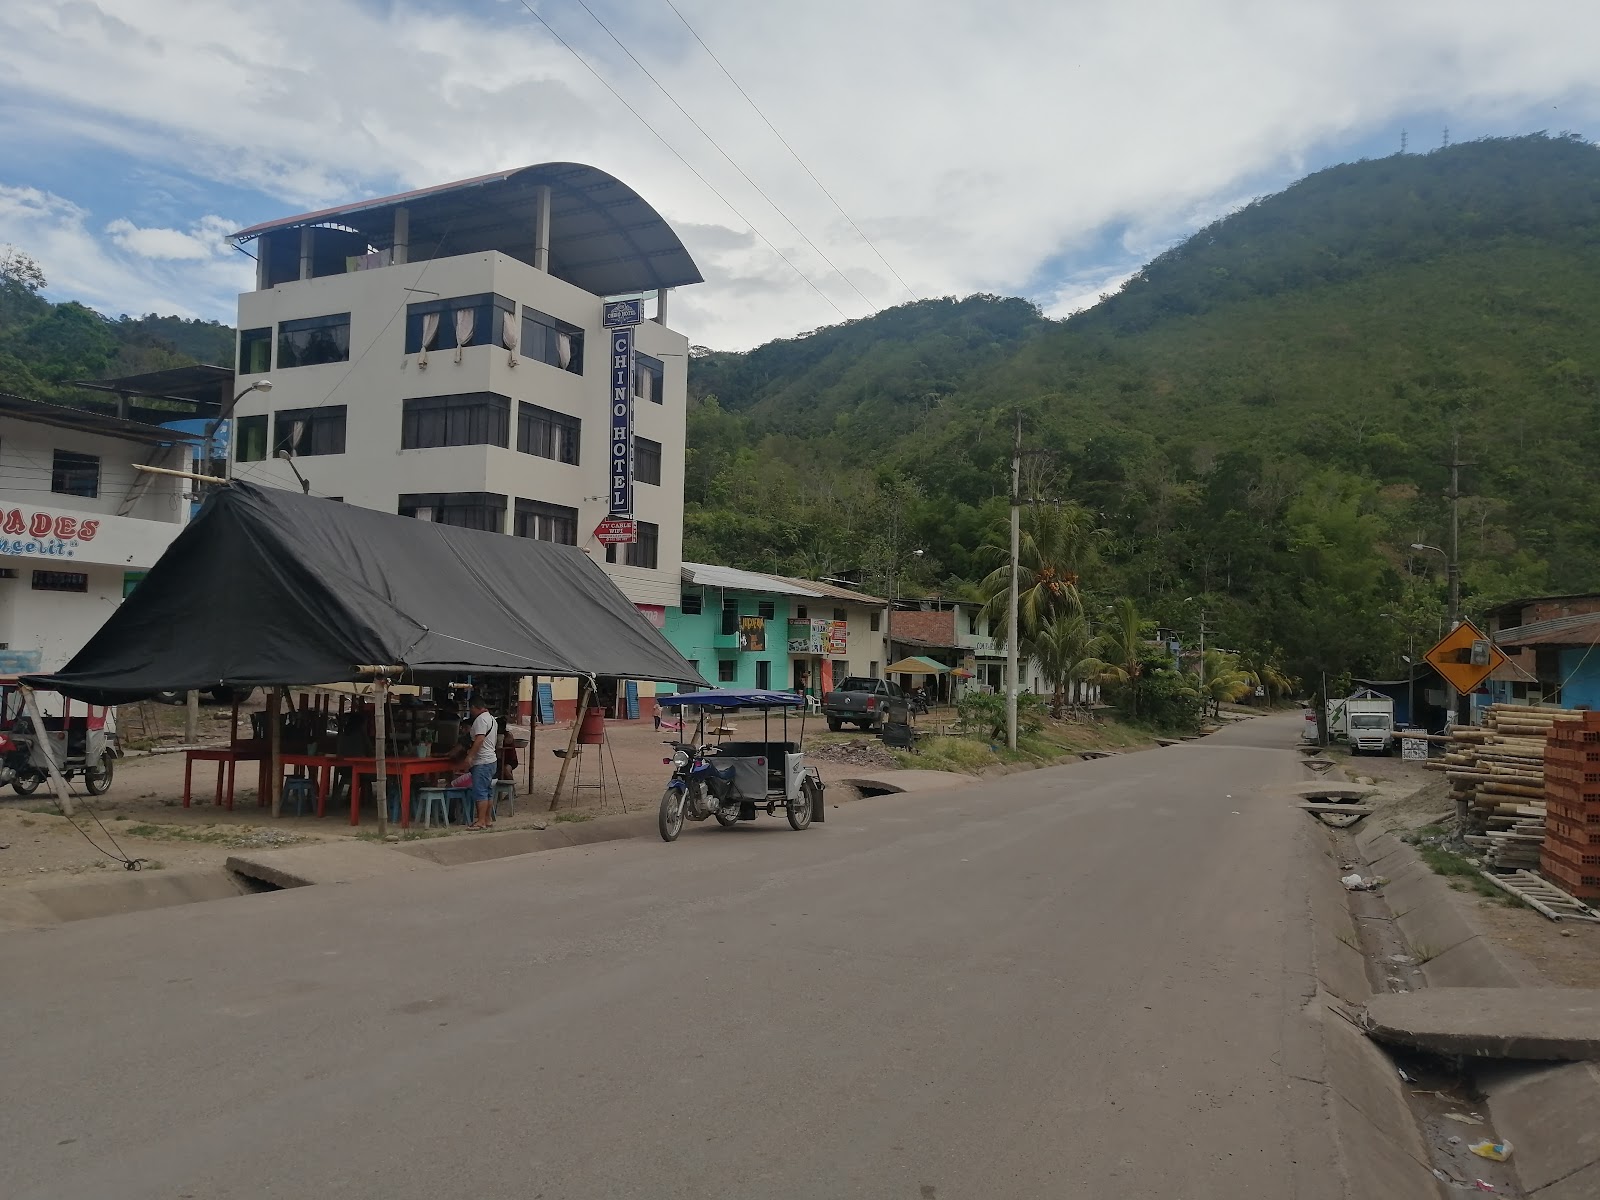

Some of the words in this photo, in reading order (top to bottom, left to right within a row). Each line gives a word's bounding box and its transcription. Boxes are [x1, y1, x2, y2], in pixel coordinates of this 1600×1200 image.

[613, 339, 627, 417] CHINO
[613, 426, 627, 505] HOTEL
[0, 508, 99, 541] ADES
